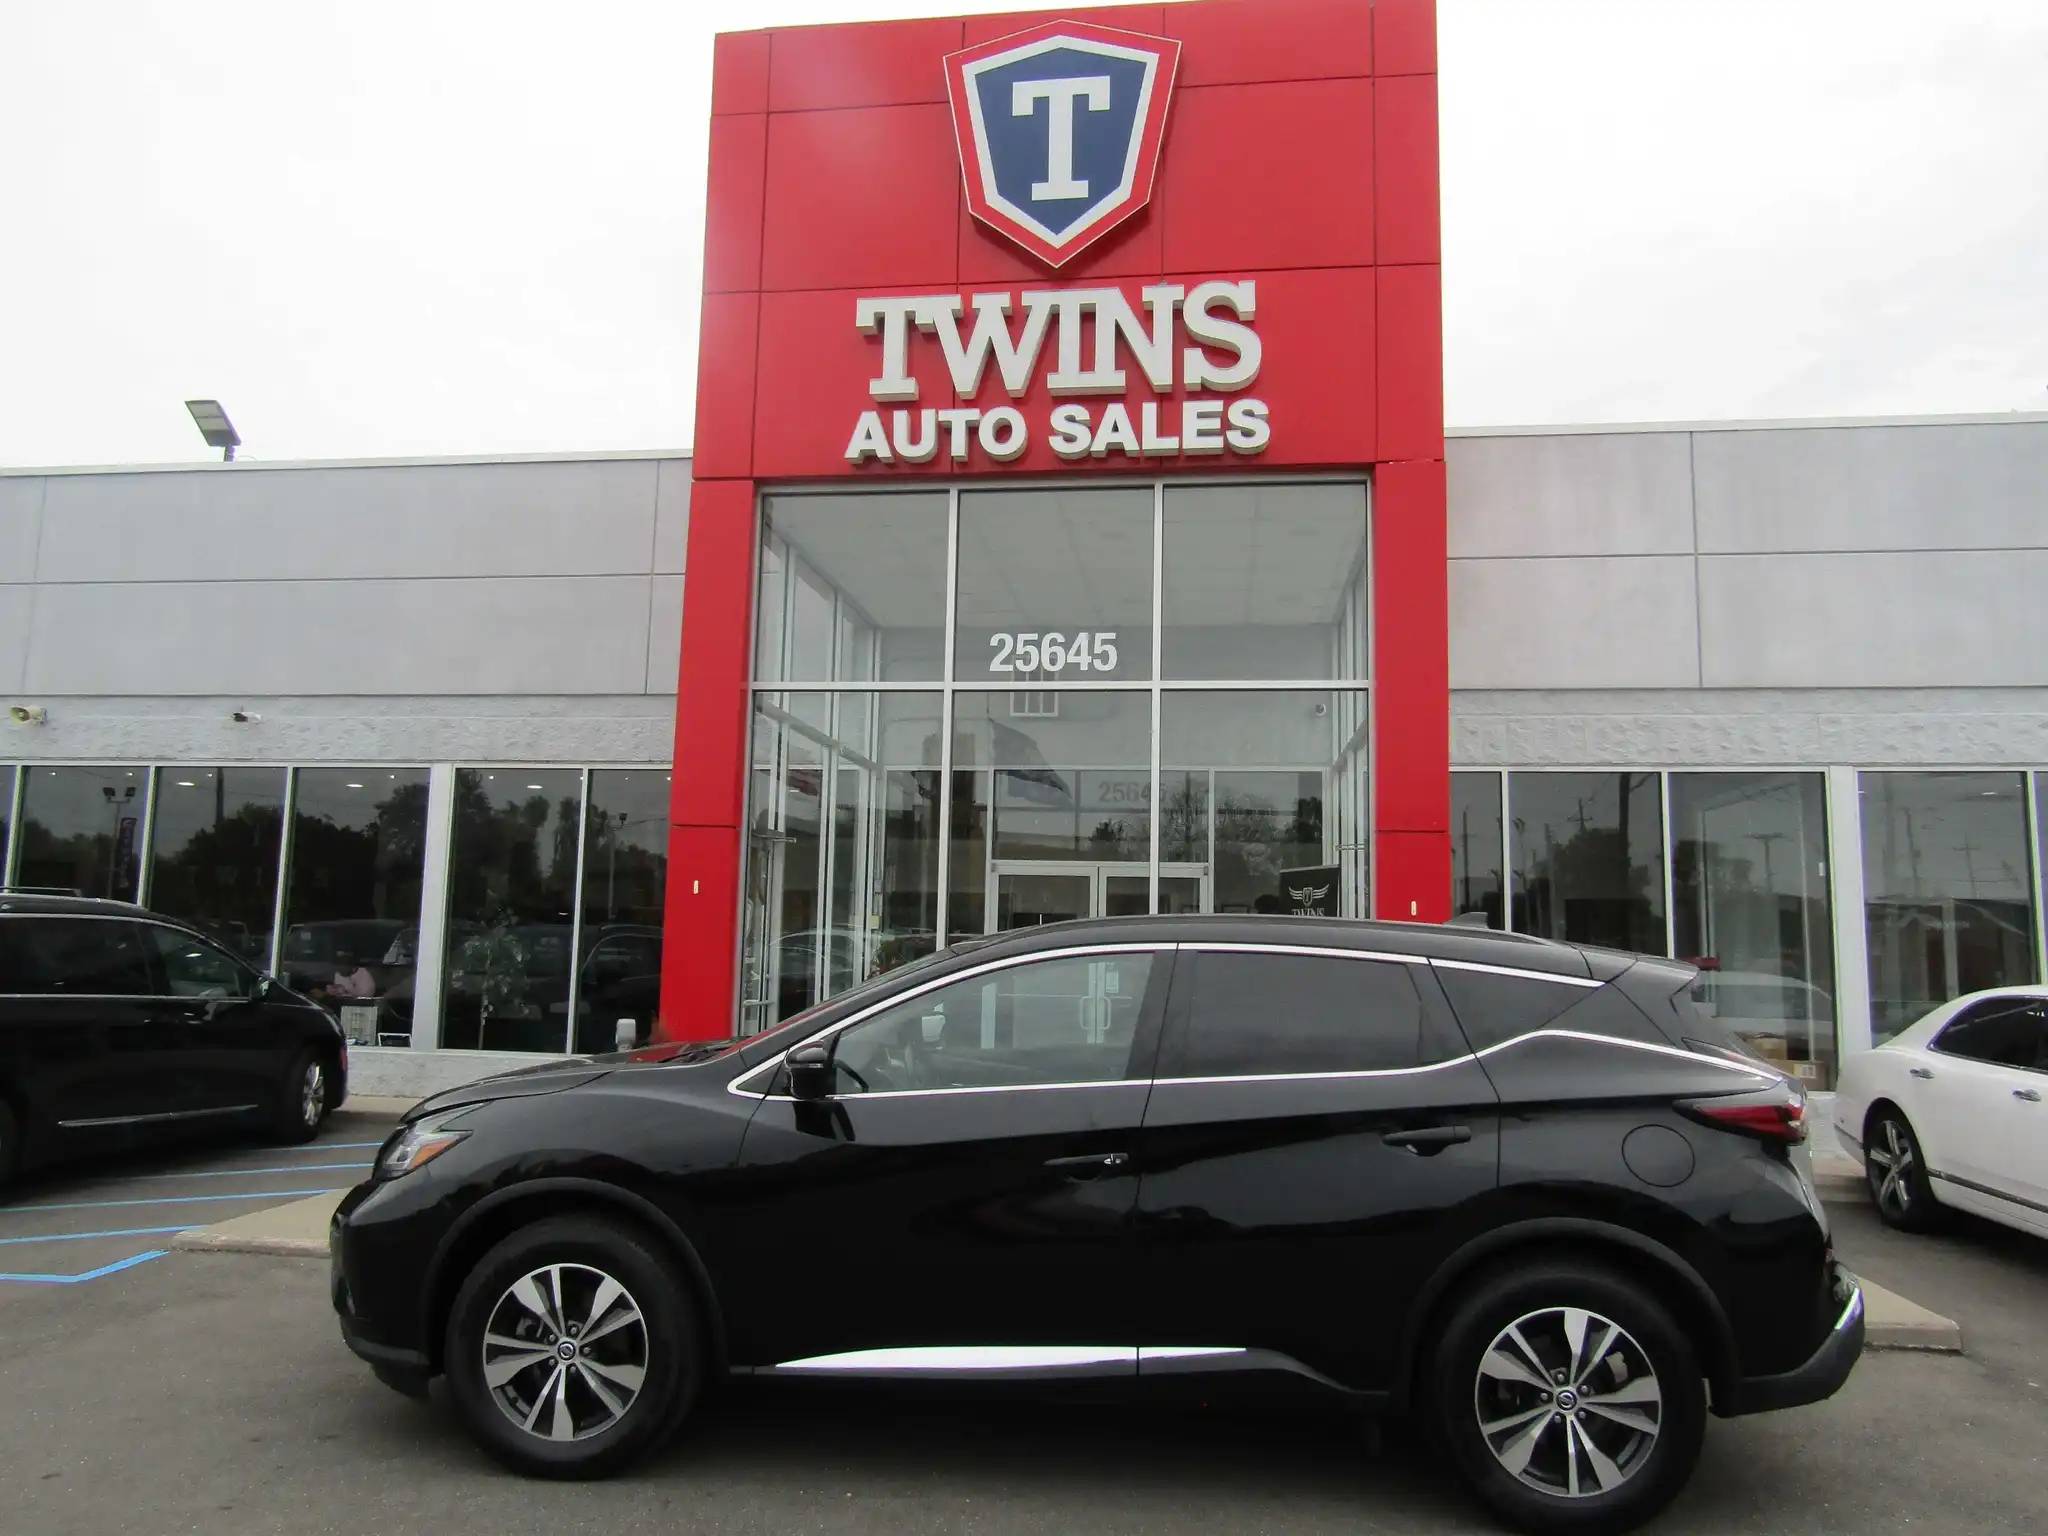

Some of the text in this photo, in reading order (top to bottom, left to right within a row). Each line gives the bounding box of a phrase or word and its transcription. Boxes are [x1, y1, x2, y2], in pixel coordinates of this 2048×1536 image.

[1012, 75, 1110, 201] T
[856, 280, 1262, 402] TWINS
[844, 400, 1271, 464] AUTO SALES
[989, 633, 1118, 672] 25645
